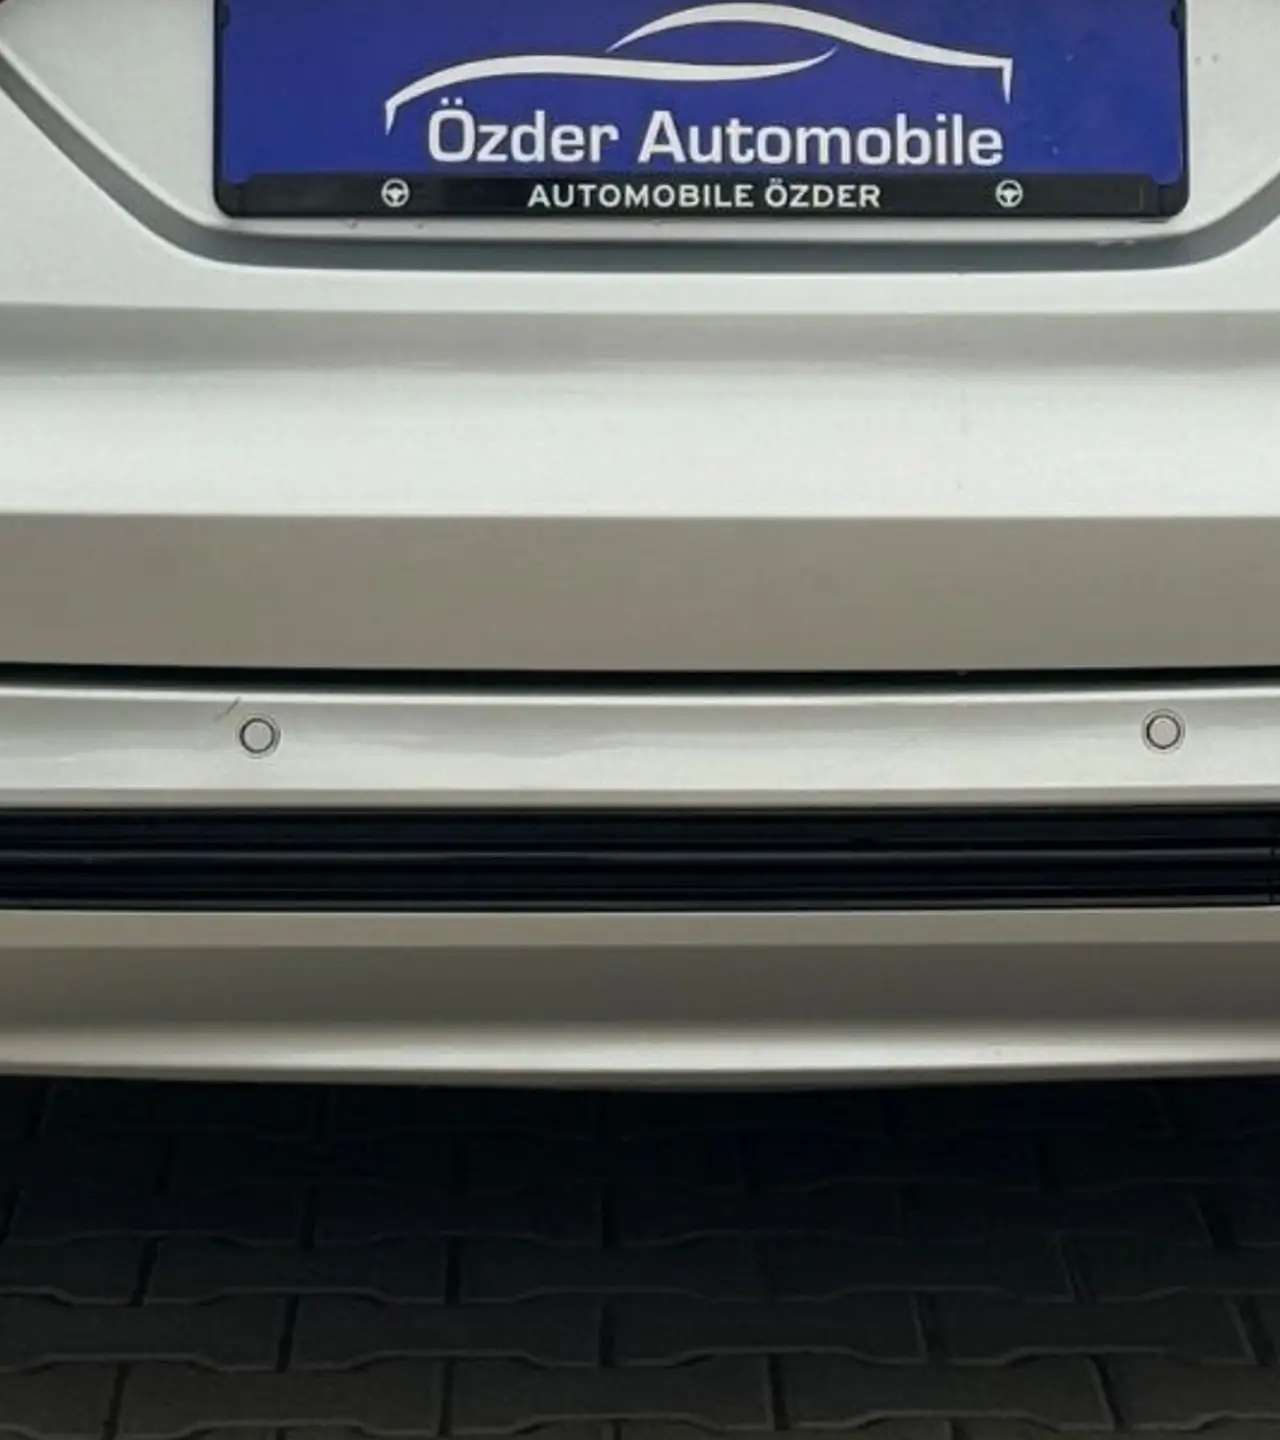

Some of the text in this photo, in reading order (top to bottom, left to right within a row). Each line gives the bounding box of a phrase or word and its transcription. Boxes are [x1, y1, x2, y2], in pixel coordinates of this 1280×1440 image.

[427, 97, 1004, 166] Özder Automobile
[526, 176, 882, 209] AUTOMOBILE ÖZDER
